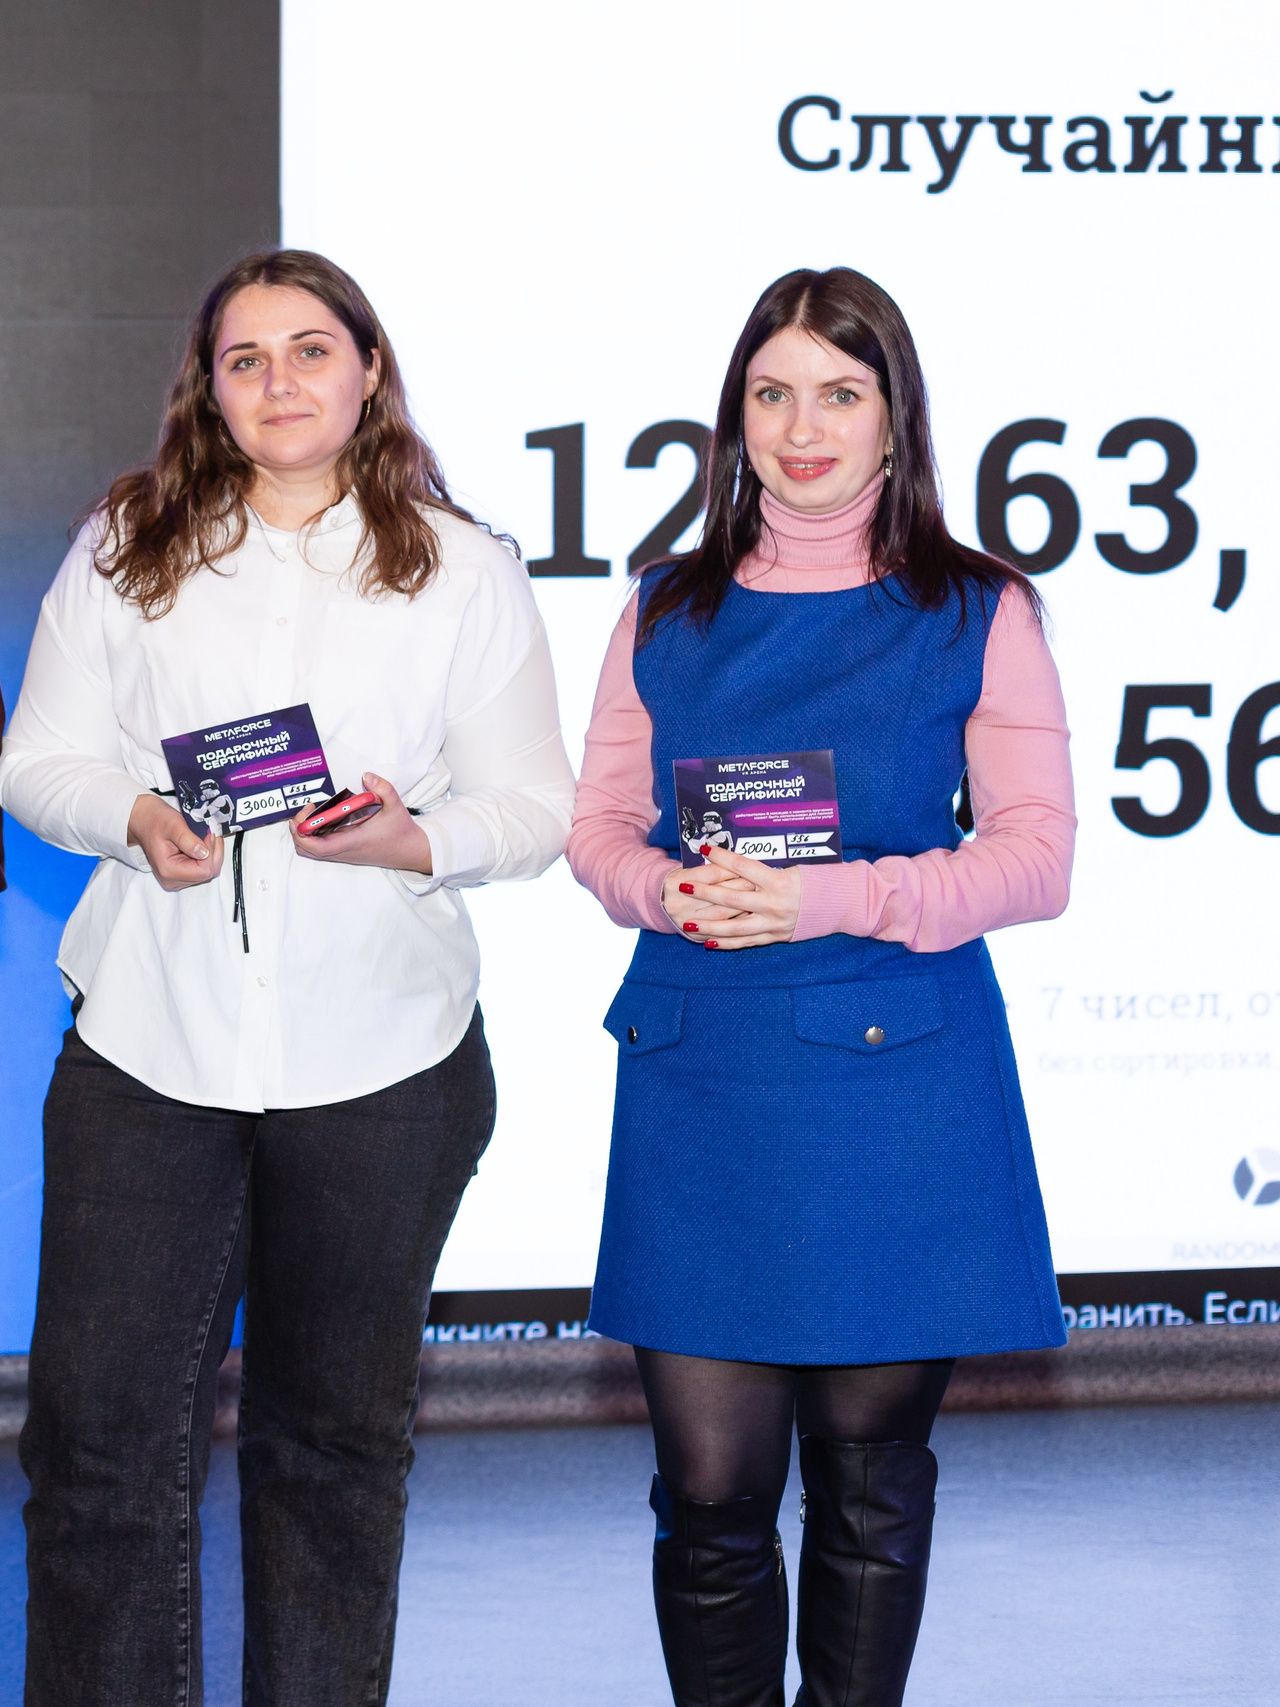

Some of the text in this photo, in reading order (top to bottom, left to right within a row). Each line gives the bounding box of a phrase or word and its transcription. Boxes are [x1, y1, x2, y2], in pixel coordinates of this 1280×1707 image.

[777, 90, 1280, 195] Случайн
[974, 415, 1248, 614] 63,
[204, 719, 272, 742] METAFORCE
[196, 731, 291, 763] ПОДАРОЧНЫЙ
[202, 742, 289, 771] СЕРТИФИКАТ
[718, 760, 789, 773] METAFORCE
[705, 775, 806, 793] ПОДАРОЧНЫЙ
[710, 787, 803, 802] СЕРТИФИКАТ
[1040, 986, 1064, 1020] 7
[1081, 991, 1232, 1024] чисел,
